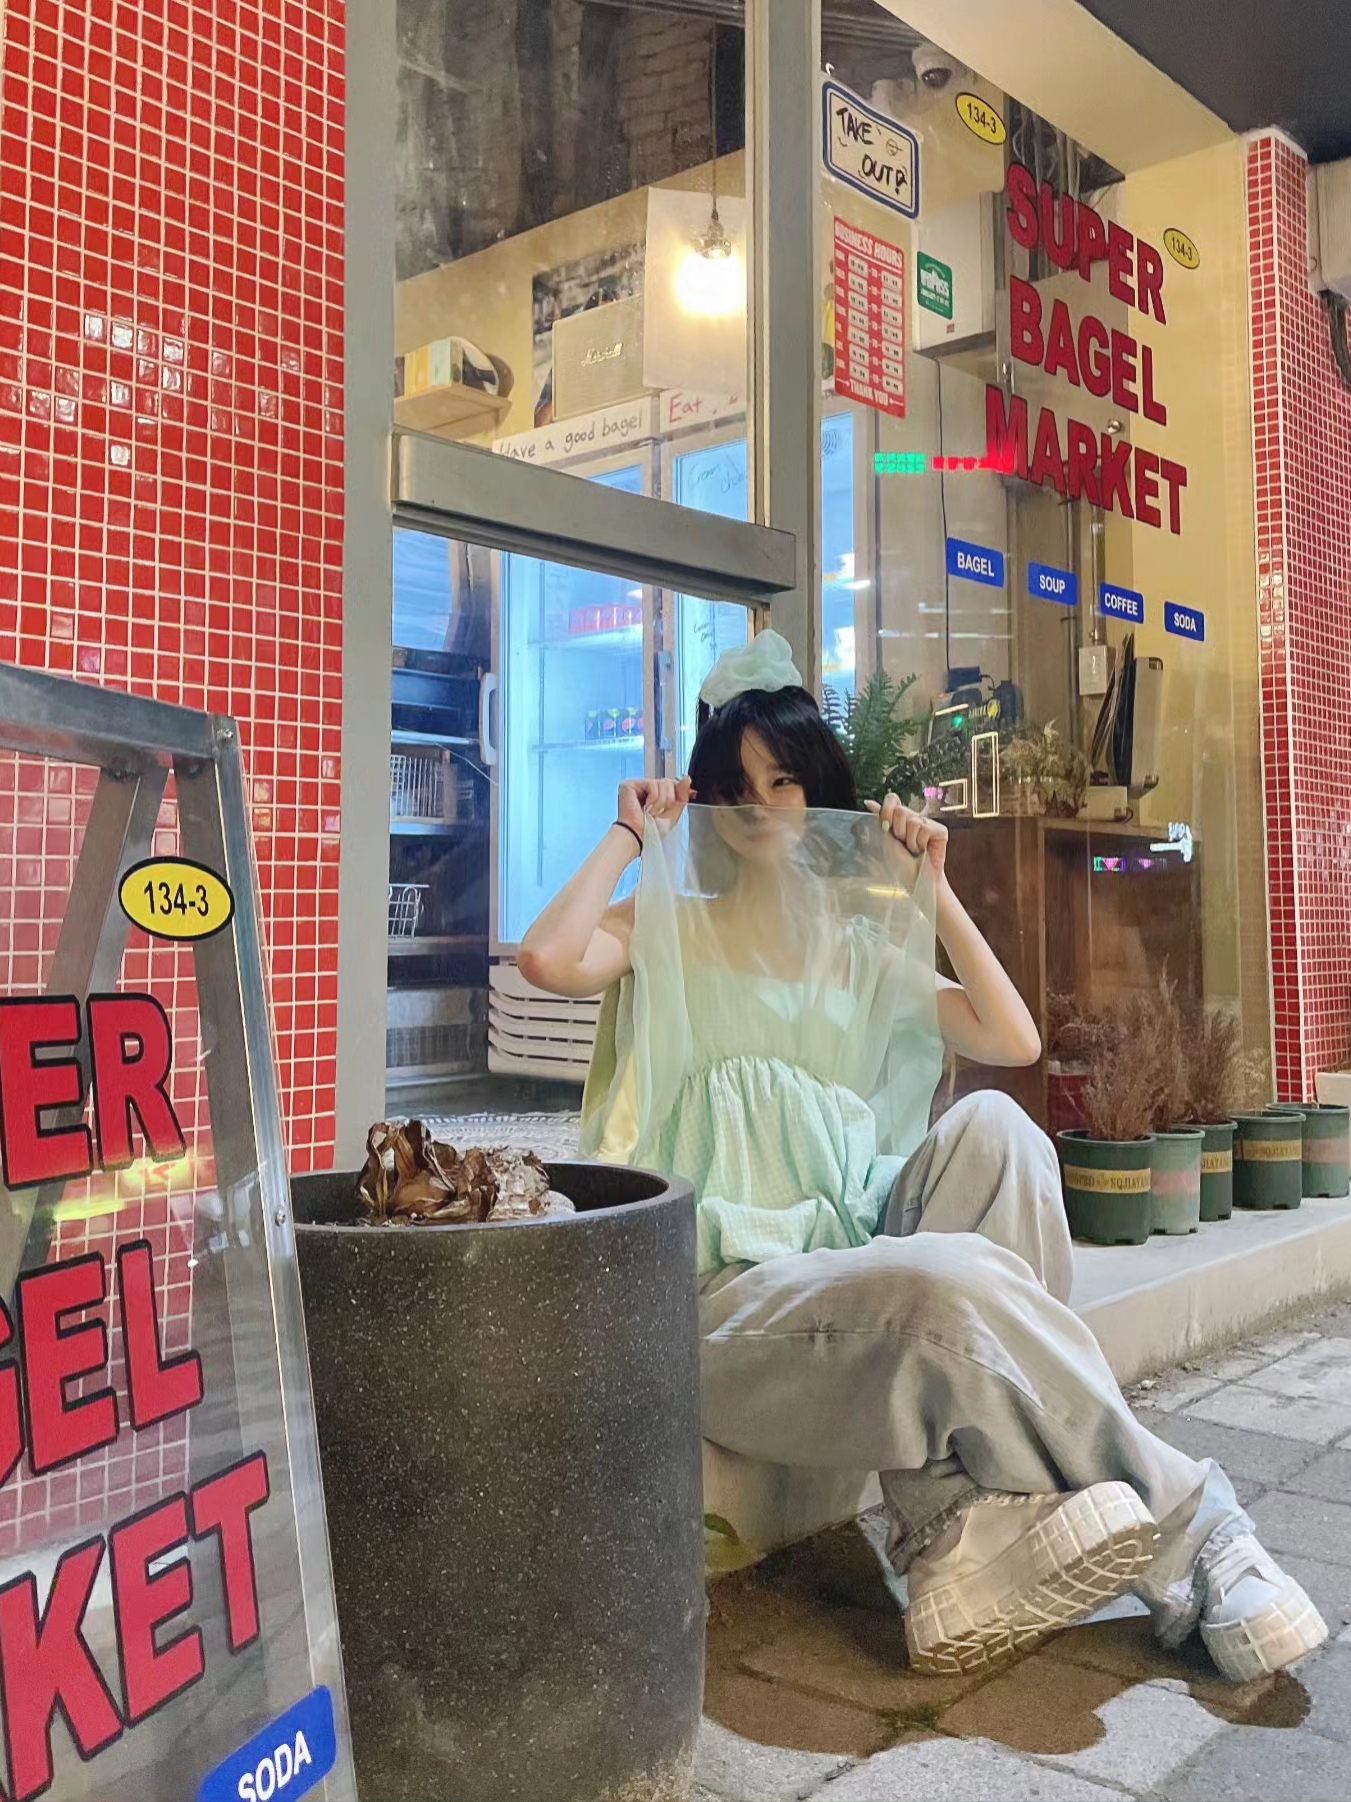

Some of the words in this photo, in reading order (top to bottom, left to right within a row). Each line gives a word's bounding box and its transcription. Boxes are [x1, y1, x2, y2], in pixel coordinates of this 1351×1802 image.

[836, 107, 874, 146] TAKE
[967, 102, 998, 134] 134-3
[1006, 162, 1167, 326] SUPER
[1171, 237, 1193, 261] 134-3
[1010, 274, 1167, 427] BAGEL
[669, 392, 702, 424] Eat
[545, 439, 556, 451] a
[565, 421, 596, 454] good
[603, 406, 643, 438] bagel
[986, 383, 1188, 536] MARKET
[957, 551, 995, 578] BAGEL
[1039, 574, 1066, 595] SOUP
[1104, 592, 1139, 616] COFFEE
[1174, 612, 1197, 633] SODA
[144, 881, 210, 917] 134-3
[237, 1731, 312, 1802] SODA
